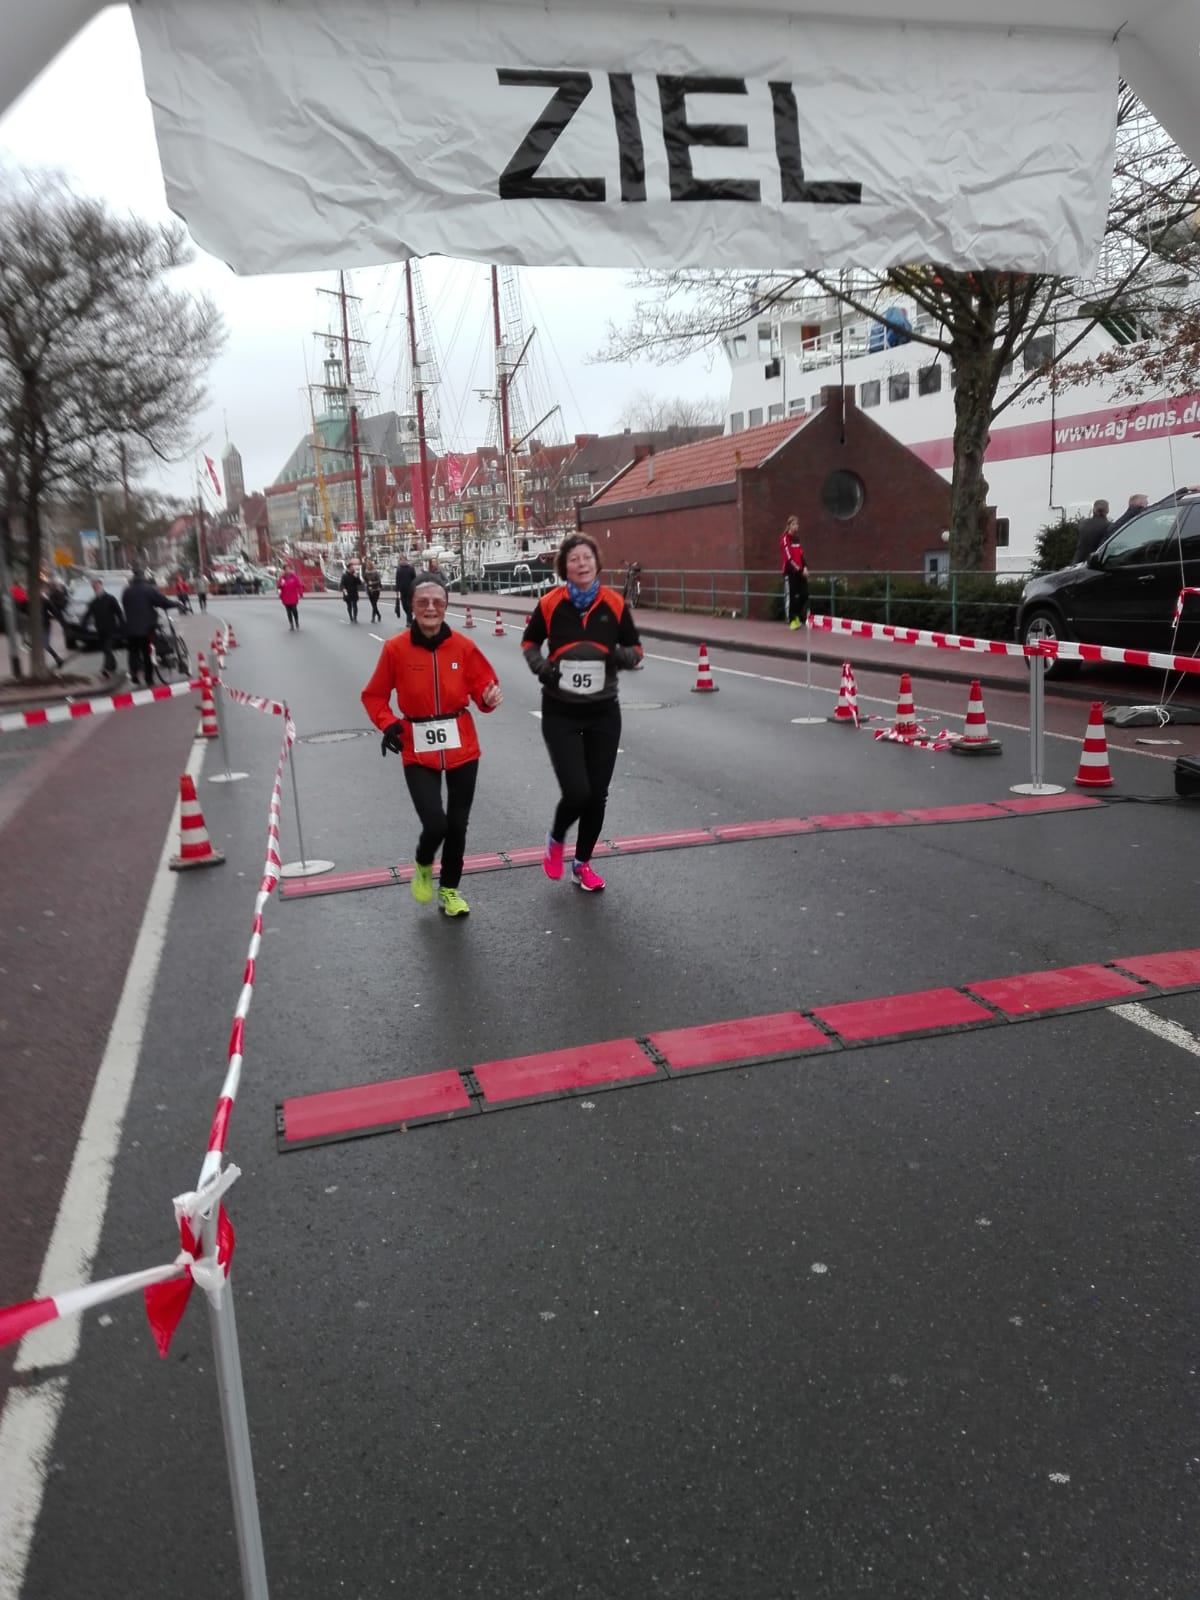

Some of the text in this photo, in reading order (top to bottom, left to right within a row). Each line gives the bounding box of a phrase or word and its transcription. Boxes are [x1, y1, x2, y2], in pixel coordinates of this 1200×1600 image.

[496, 68, 862, 204] ZIEL
[572, 673, 593, 688] 95
[425, 728, 447, 745] 96
